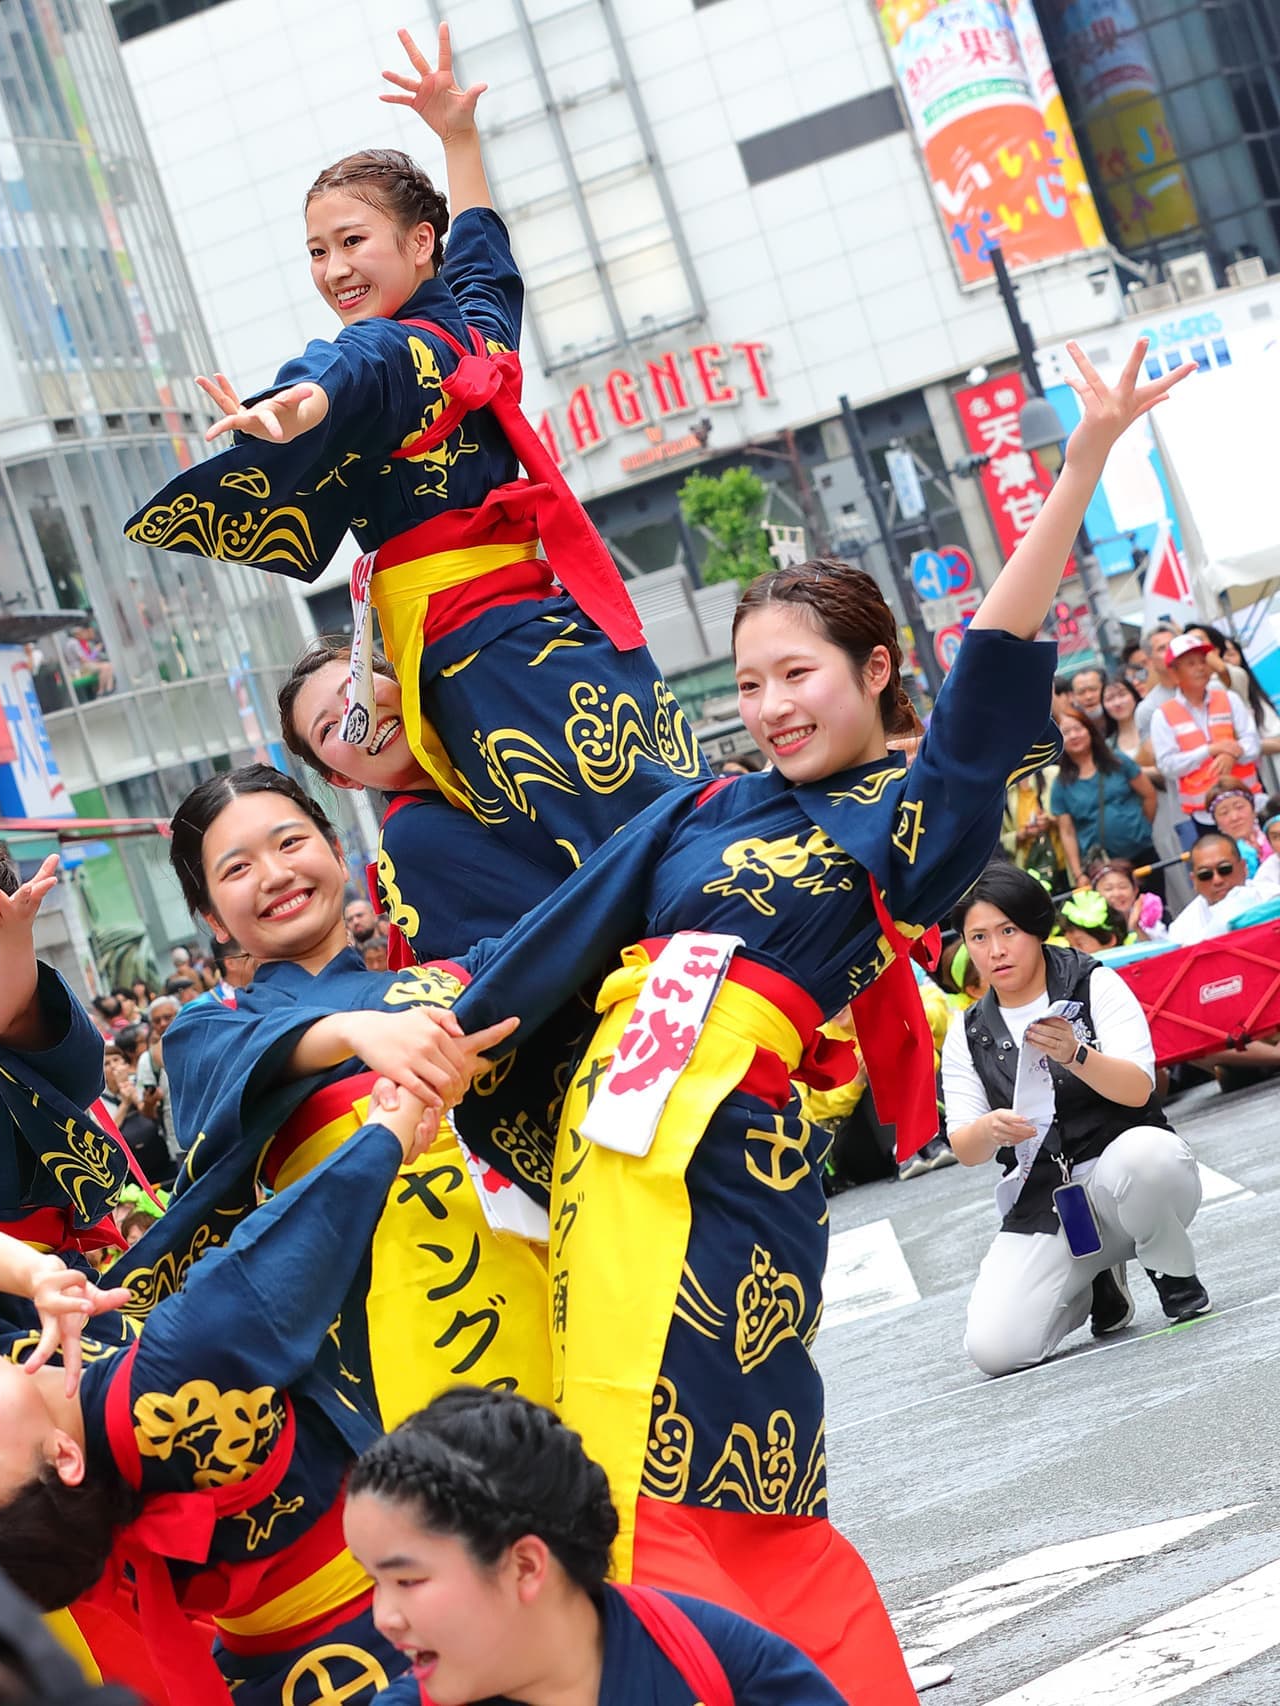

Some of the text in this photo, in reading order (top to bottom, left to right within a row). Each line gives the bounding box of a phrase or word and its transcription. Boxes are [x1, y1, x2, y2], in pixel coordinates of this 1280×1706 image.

[977, 412, 1050, 550] 天津甘
[607, 940, 720, 1096] はら祭
[396, 1163, 518, 1393] ヤング
